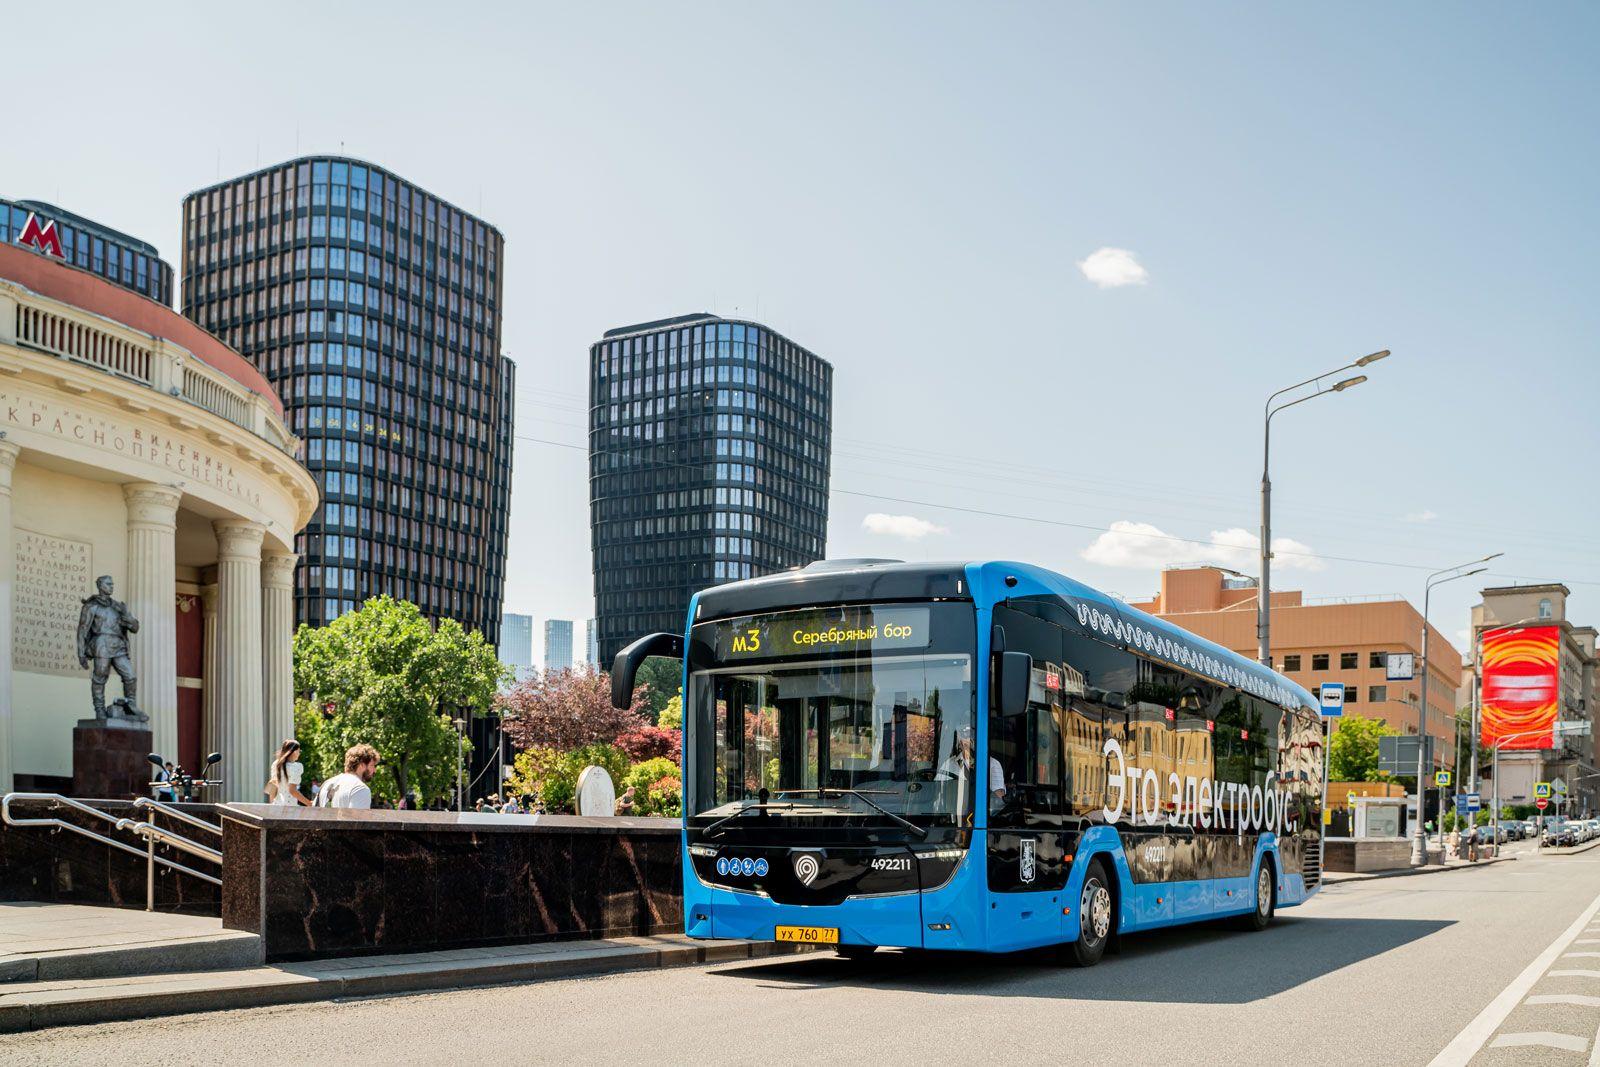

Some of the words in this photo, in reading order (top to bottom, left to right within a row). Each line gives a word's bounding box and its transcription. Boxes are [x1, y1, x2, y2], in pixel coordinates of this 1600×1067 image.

[8, 405, 262, 505] КРАСНОПРЕСНЕНСКАЯ
[15, 605, 79, 622] ДОТОЧИЛИС
[50, 601, 80, 612] СОСР
[15, 625, 73, 640] ДРУЖИН
[792, 625, 878, 646] Серебряный
[884, 622, 912, 641] бор
[15, 637, 75, 650] КОТОРЫМ
[15, 646, 77, 661] РУКОВОДИЛ
[1103, 738, 1160, 826] Это
[870, 858, 911, 871] 492211
[798, 928, 818, 941] 760
[824, 928, 835, 938] 77
